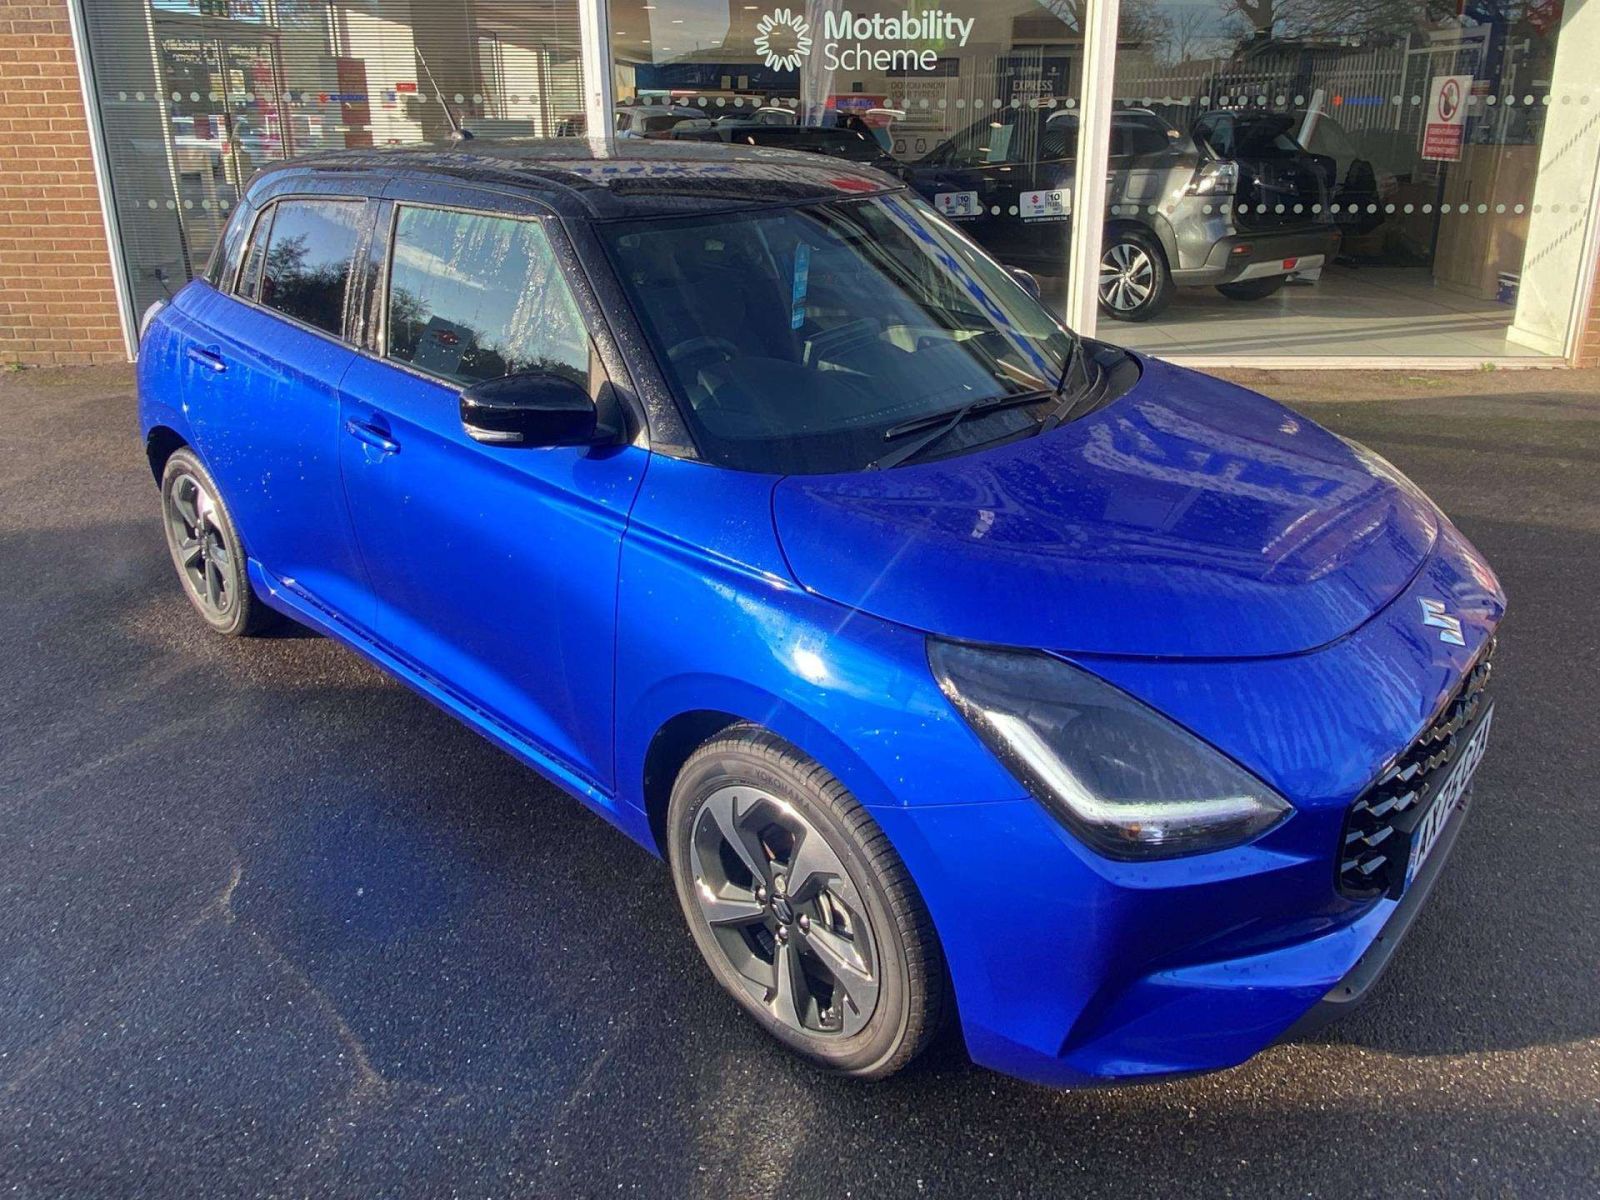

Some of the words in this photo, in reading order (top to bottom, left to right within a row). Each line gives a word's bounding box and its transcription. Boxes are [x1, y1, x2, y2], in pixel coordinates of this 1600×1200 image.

[824, 10, 975, 47] Motability
[824, 43, 938, 71] Scheme
[1013, 80, 1053, 91] EXPRESS
[1050, 193, 1060, 201] 10
